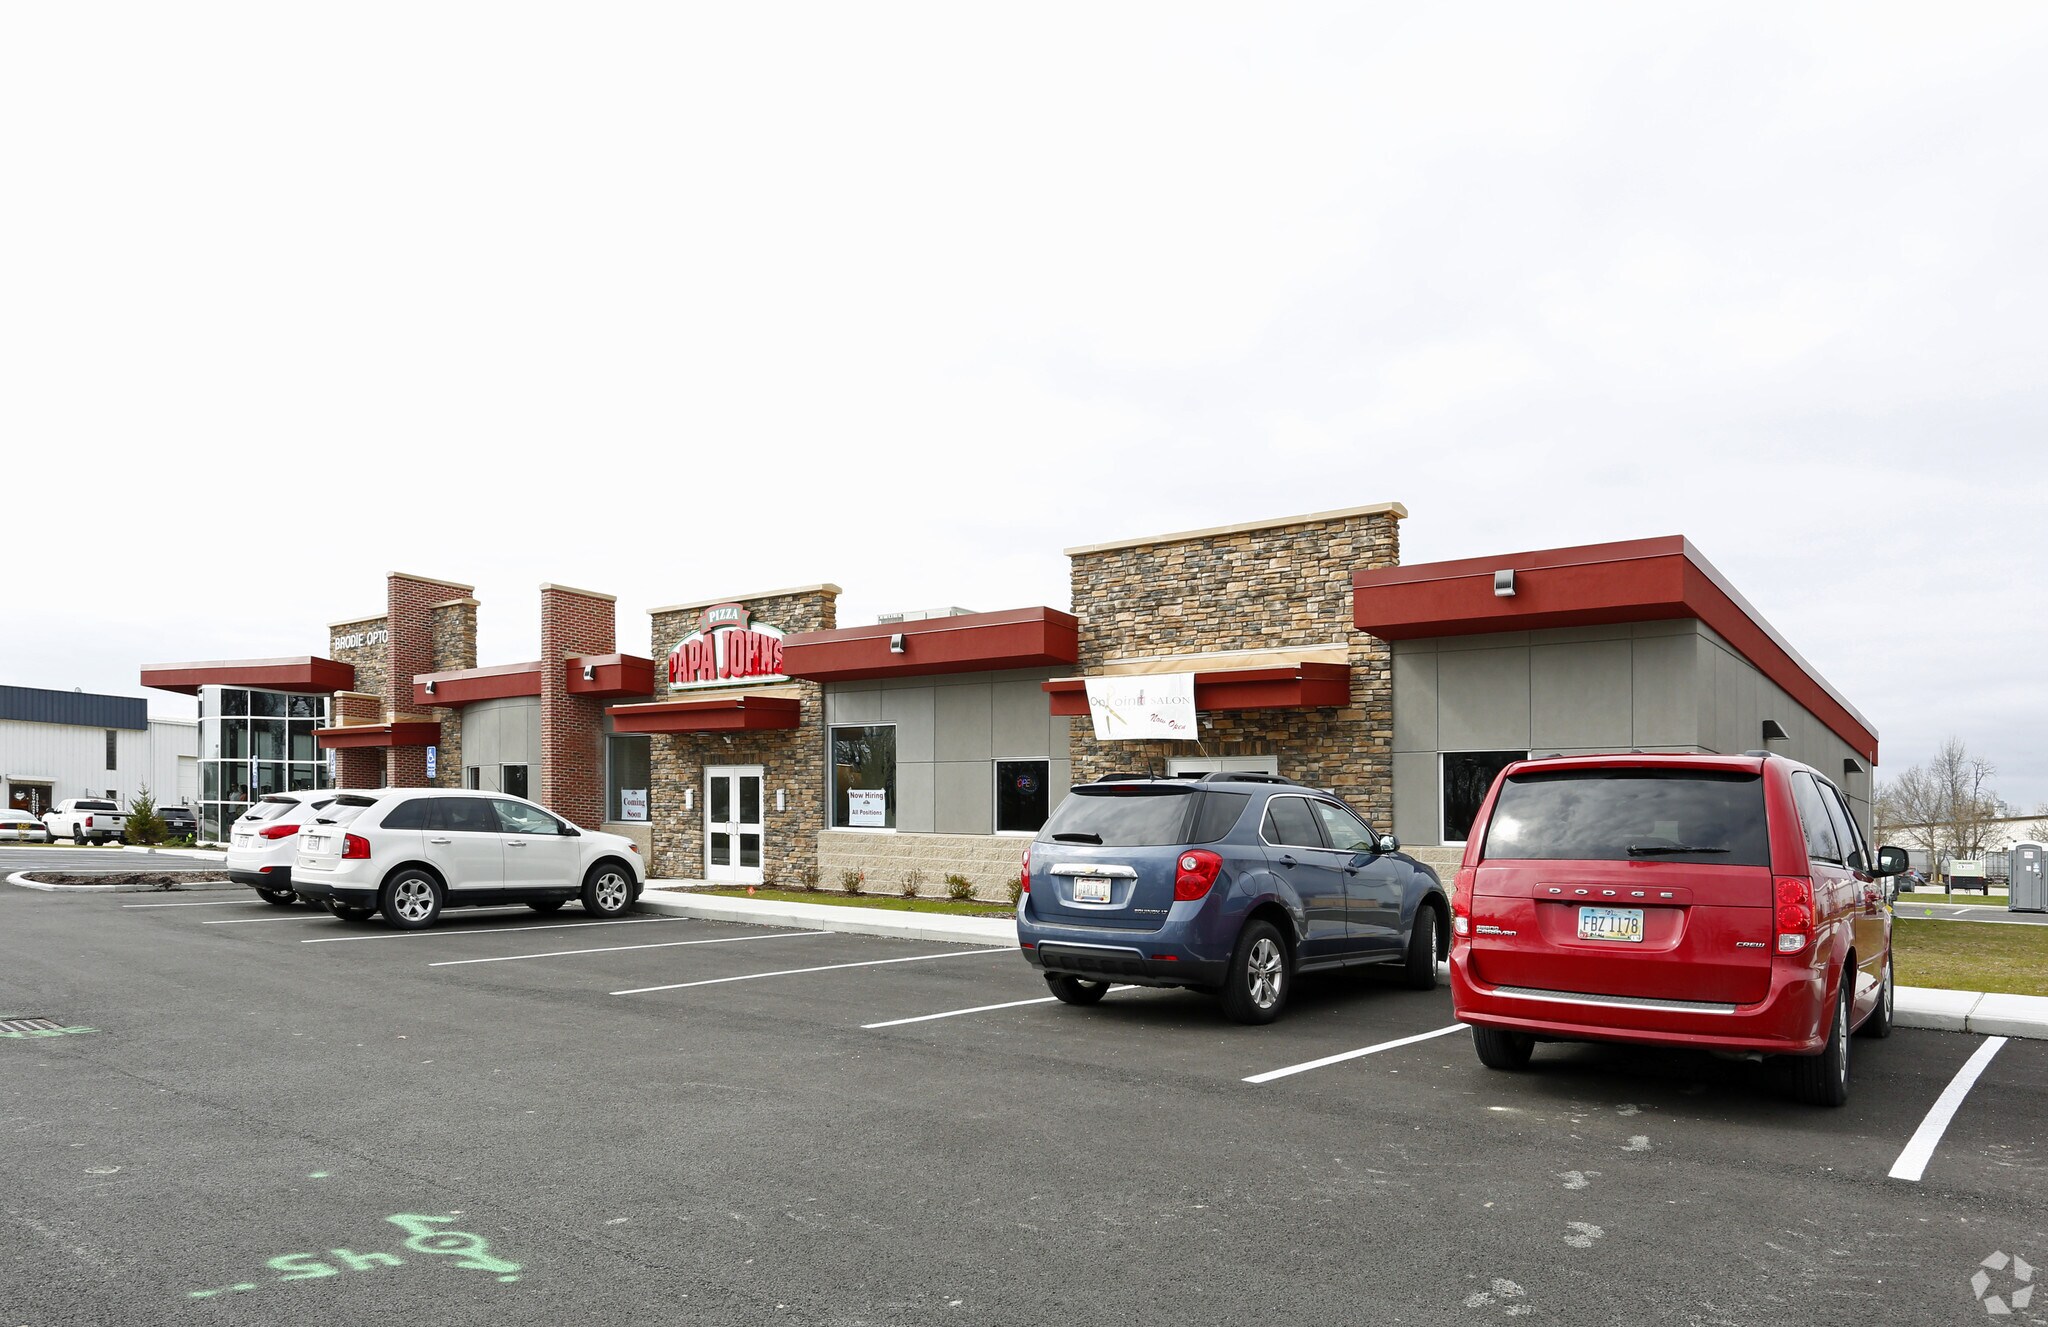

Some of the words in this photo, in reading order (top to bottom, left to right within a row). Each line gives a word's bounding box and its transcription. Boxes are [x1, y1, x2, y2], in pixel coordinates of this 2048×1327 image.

[708, 608, 738, 622] PIZZA
[335, 633, 364, 650] BRODIE
[669, 633, 717, 683] PAPA
[1151, 696, 1190, 705] SALON
[1150, 713, 1166, 724] Now
[1168, 719, 1187, 730] Open
[623, 797, 645, 807] Coming
[850, 791, 863, 799] Now
[864, 791, 884, 801] Hiring
[627, 810, 641, 818] Soon
[1549, 887, 1673, 898] DODGE
[1583, 915, 1605, 933] FBZ
[1609, 916, 1638, 934] 1178
